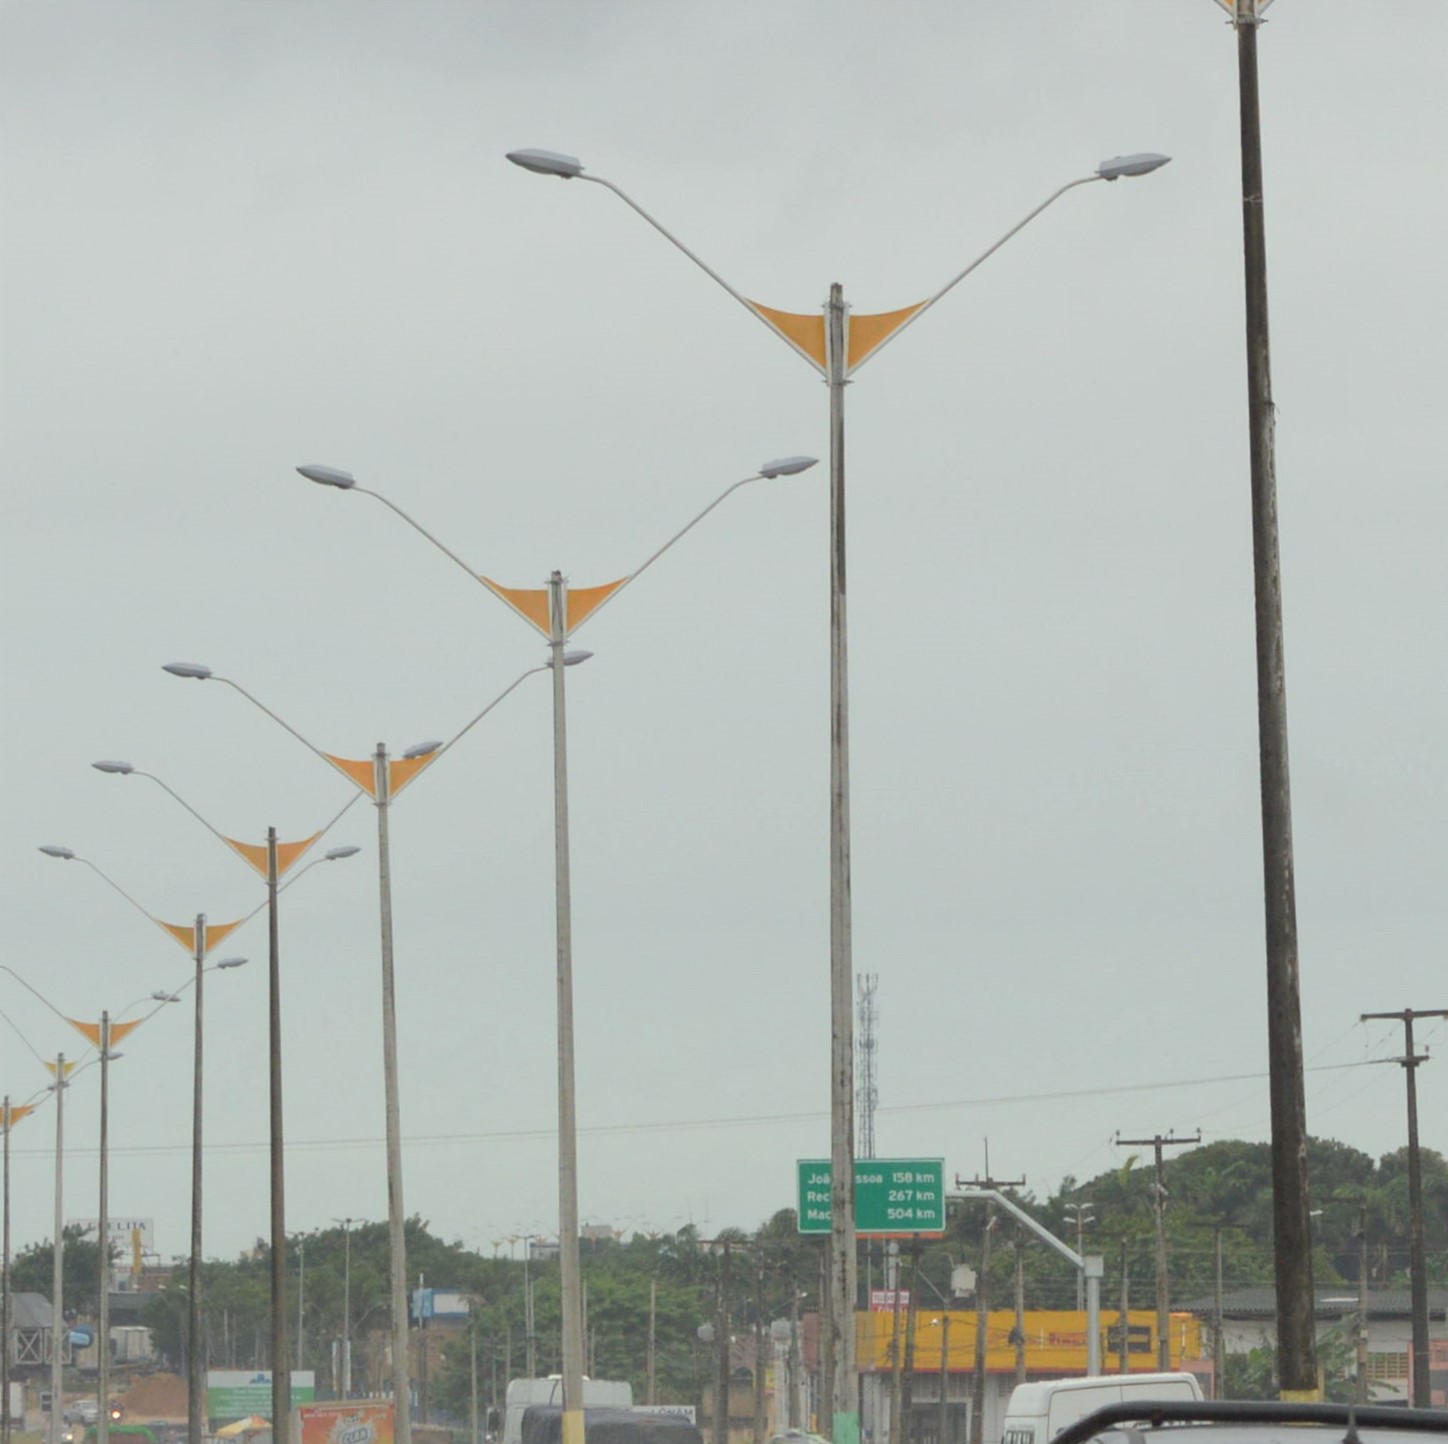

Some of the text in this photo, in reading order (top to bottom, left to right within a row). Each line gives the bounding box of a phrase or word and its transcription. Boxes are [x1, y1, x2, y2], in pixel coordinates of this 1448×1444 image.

[807, 1173, 831, 1185] Joã
[855, 1174, 883, 1184] ssoa
[916, 1172, 935, 1184] km
[888, 1190, 913, 1202] 267
[916, 1190, 935, 1201] km
[887, 1208, 913, 1220] 504
[916, 1208, 936, 1219] km
